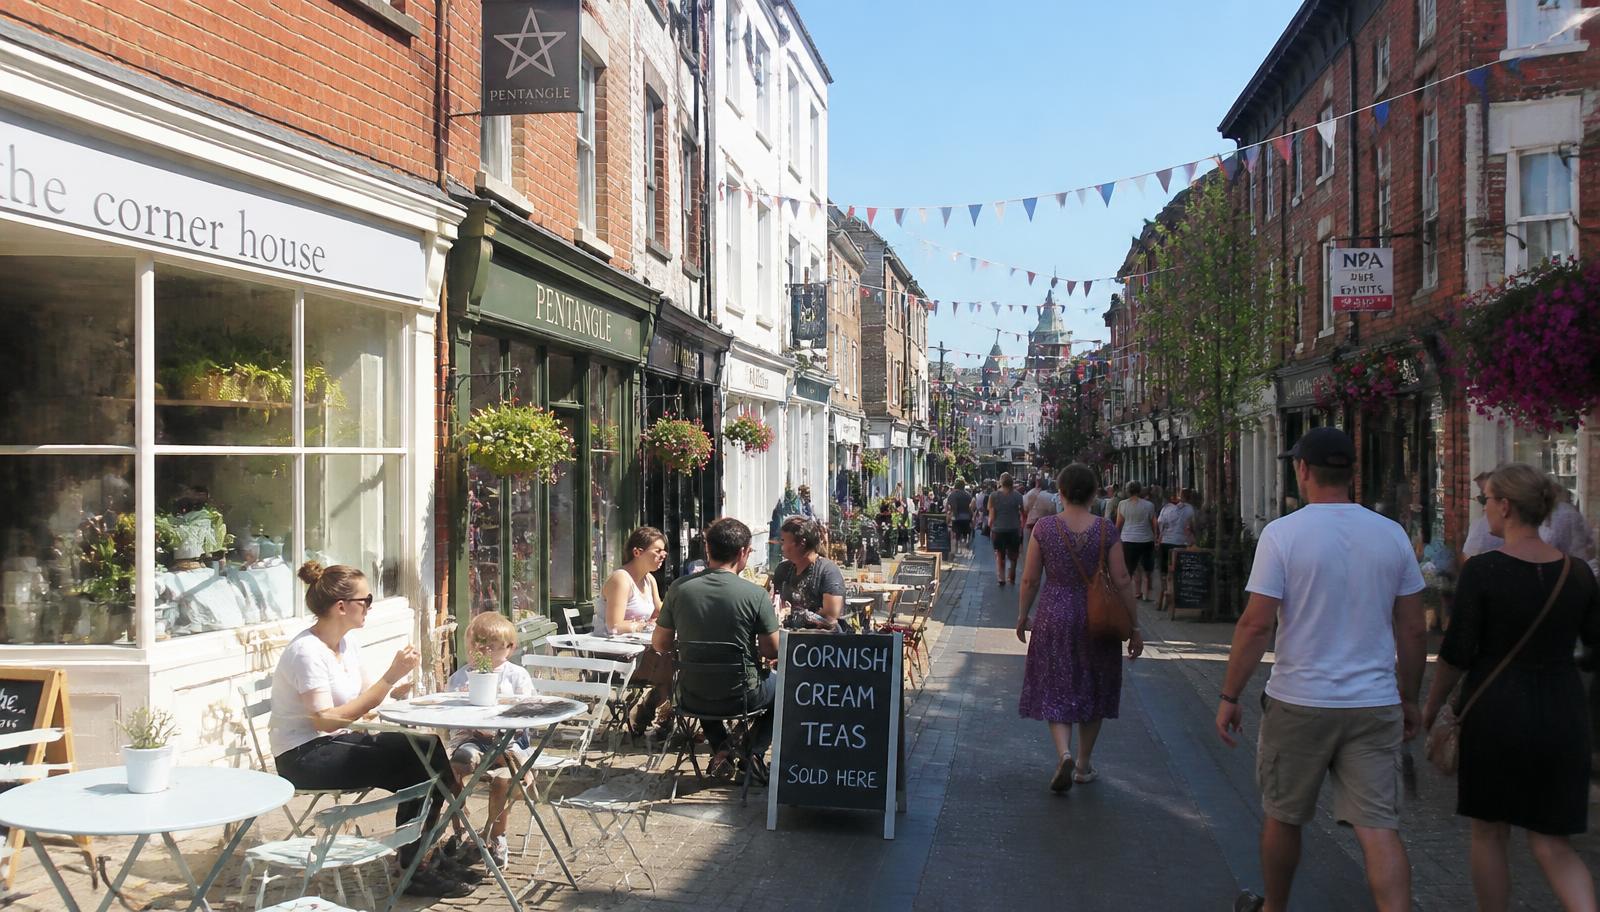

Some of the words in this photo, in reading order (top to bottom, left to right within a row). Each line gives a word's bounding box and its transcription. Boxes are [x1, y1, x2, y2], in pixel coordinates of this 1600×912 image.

[490, 87, 571, 101] PENTANGLE
[93, 192, 223, 250] corner
[238, 209, 326, 274] house
[536, 284, 612, 342] PENTANGLE
[792, 643, 888, 673] CORNISH
[795, 681, 874, 710] CREAM
[800, 721, 867, 749] TEAS
[787, 764, 828, 785] SOLD
[836, 769, 878, 789] HERE
